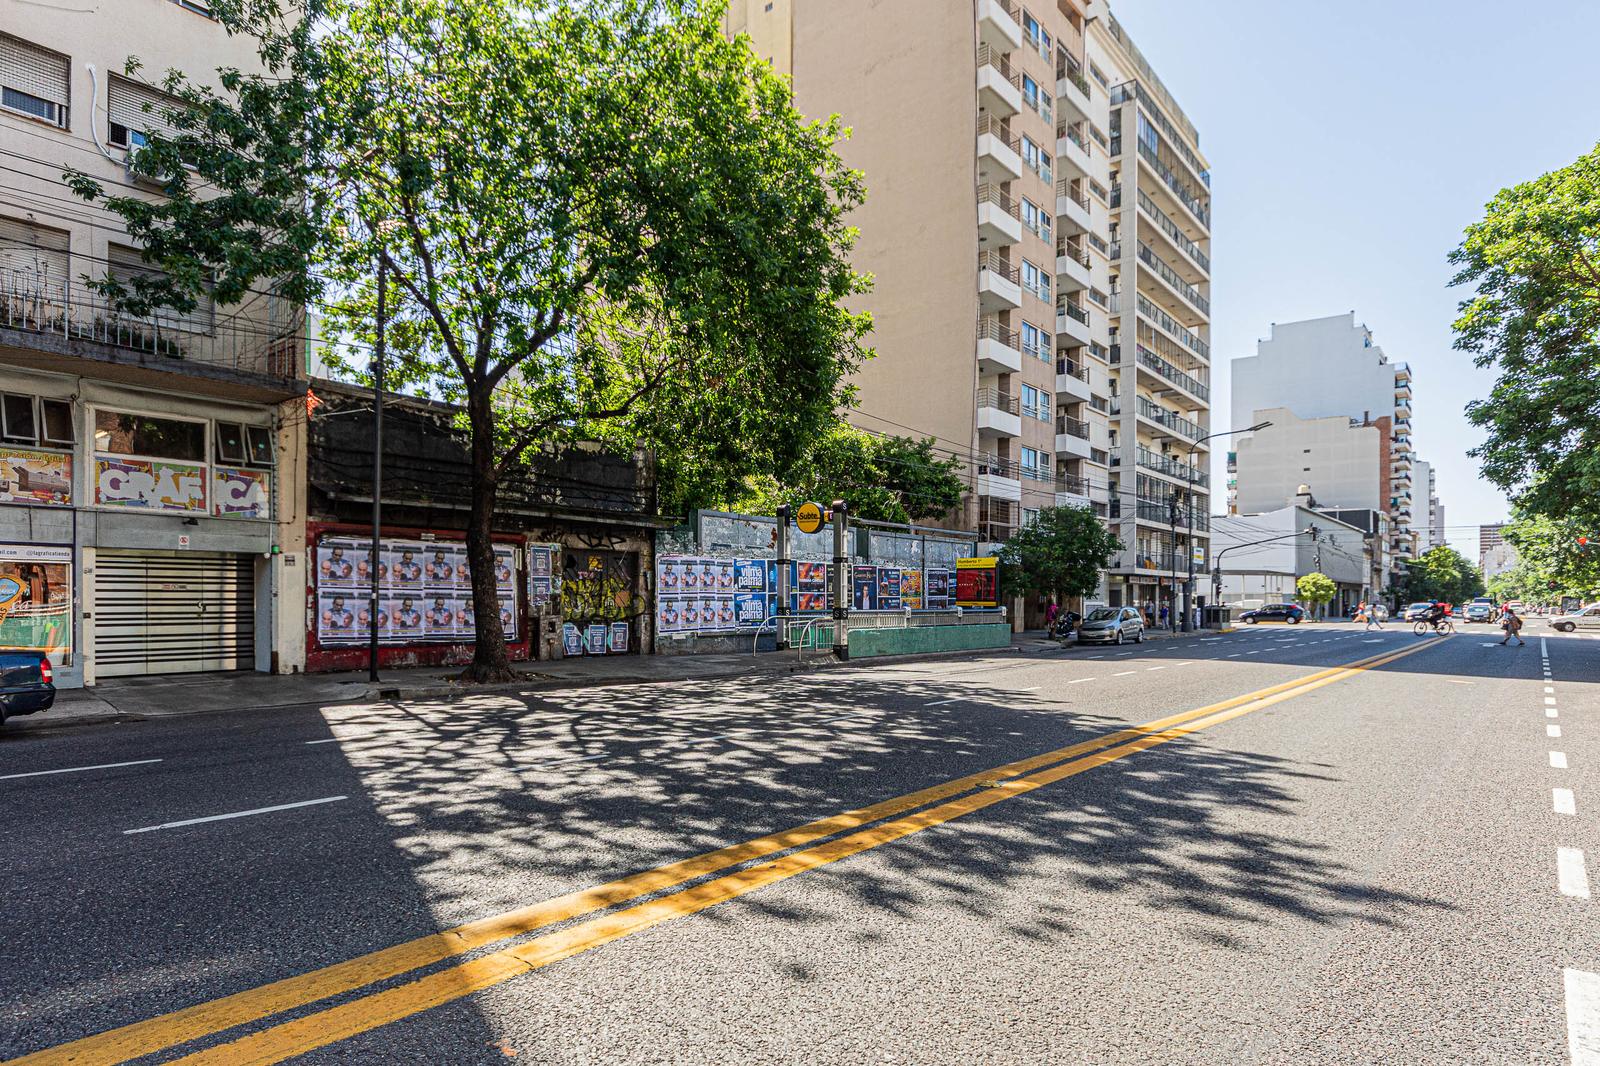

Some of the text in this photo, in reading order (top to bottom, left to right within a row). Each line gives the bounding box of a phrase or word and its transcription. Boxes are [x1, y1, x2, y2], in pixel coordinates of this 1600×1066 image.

[799, 512, 818, 520] Subte
[741, 565, 763, 577] vilma
[738, 575, 763, 588] palma
[741, 600, 763, 611] vilma
[739, 609, 763, 622] palma
